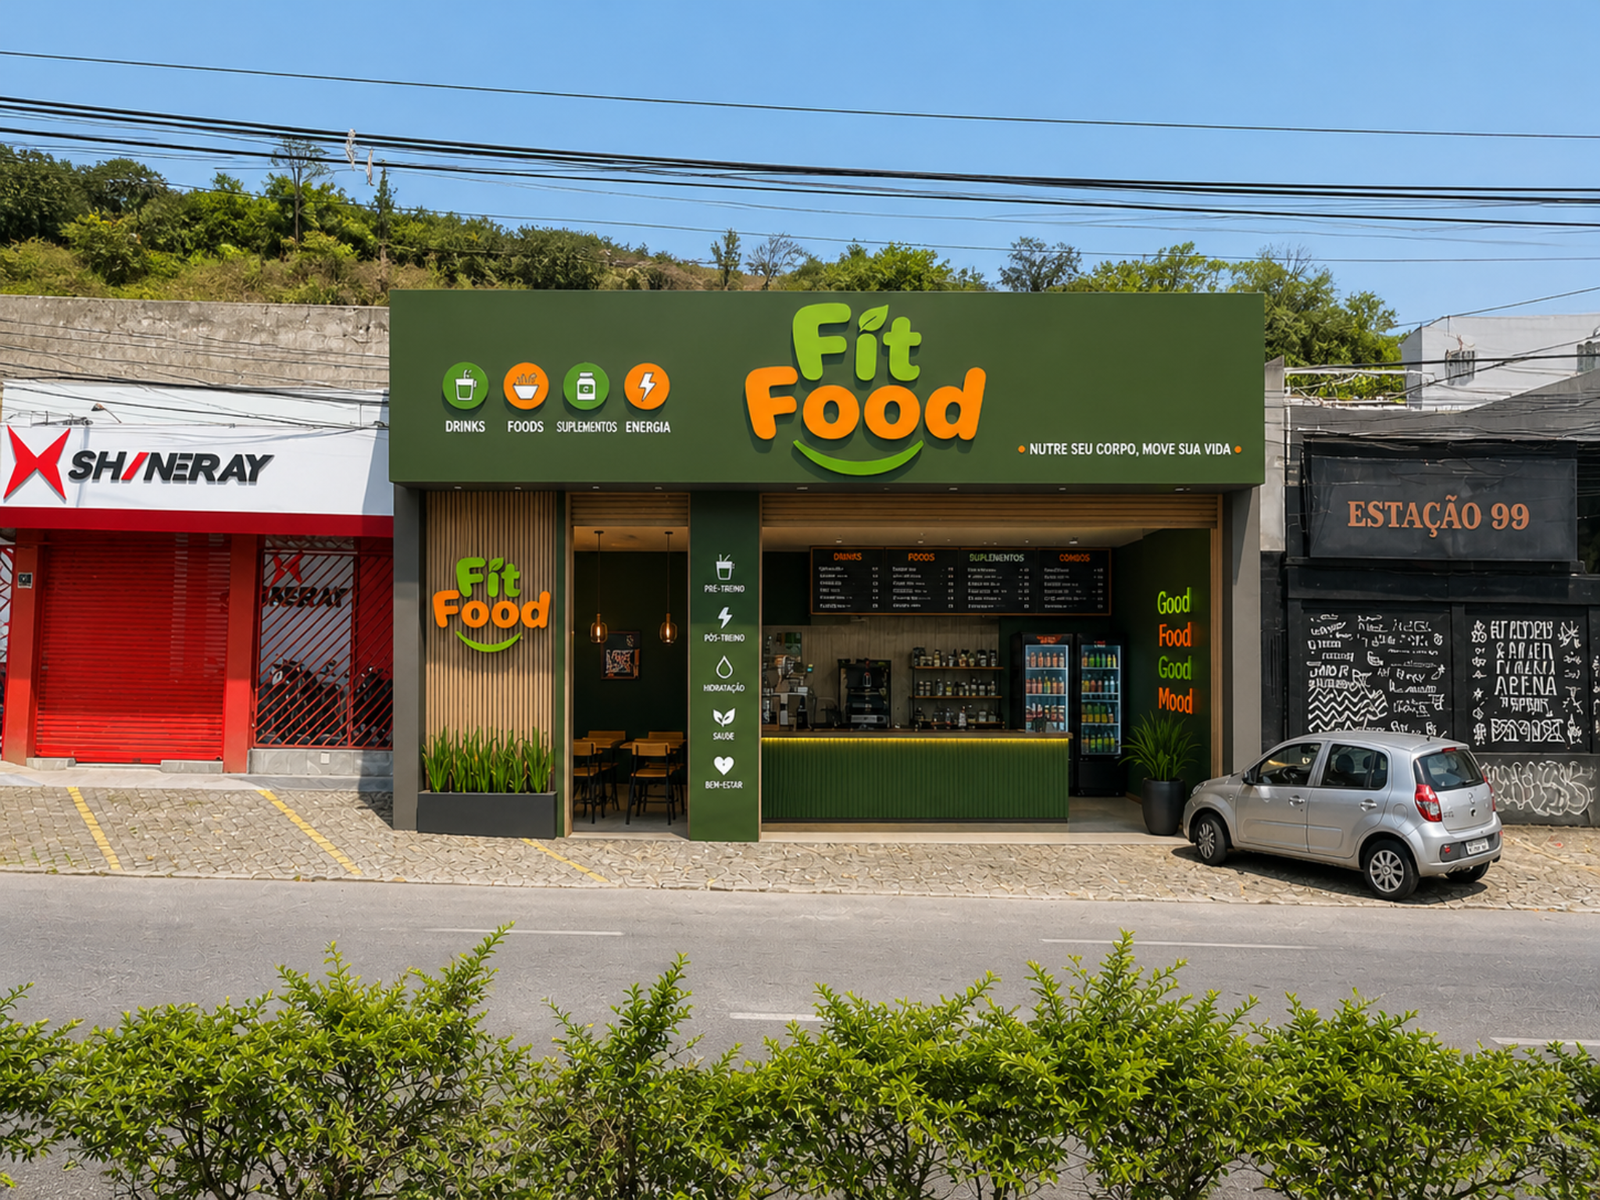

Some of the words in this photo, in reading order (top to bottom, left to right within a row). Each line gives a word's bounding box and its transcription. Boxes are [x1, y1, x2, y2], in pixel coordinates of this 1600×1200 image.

[792, 303, 922, 381] Fit
[745, 366, 987, 440] Food
[445, 420, 486, 433] DRINKS
[507, 420, 544, 433] FOODS
[556, 420, 618, 433] SUPLEMENTOS
[625, 420, 671, 434] ENERGIA
[1029, 442, 1068, 455] NUTRE
[1071, 442, 1093, 455] SEU
[1096, 442, 1140, 457] CORPO,
[1142, 442, 1176, 455] MOVE
[1178, 443, 1202, 456] SUA
[1204, 443, 1232, 456] VIDA
[68, 450, 274, 483] SHINERAY
[1347, 494, 1482, 538] ESTAÇÃO
[1491, 503, 1530, 530] 99
[456, 557, 521, 598] Fit
[432, 589, 551, 628] Food
[1157, 587, 1192, 615] Good
[1158, 621, 1192, 647] Food
[1158, 655, 1192, 681] Good
[1158, 686, 1193, 714] Mood
